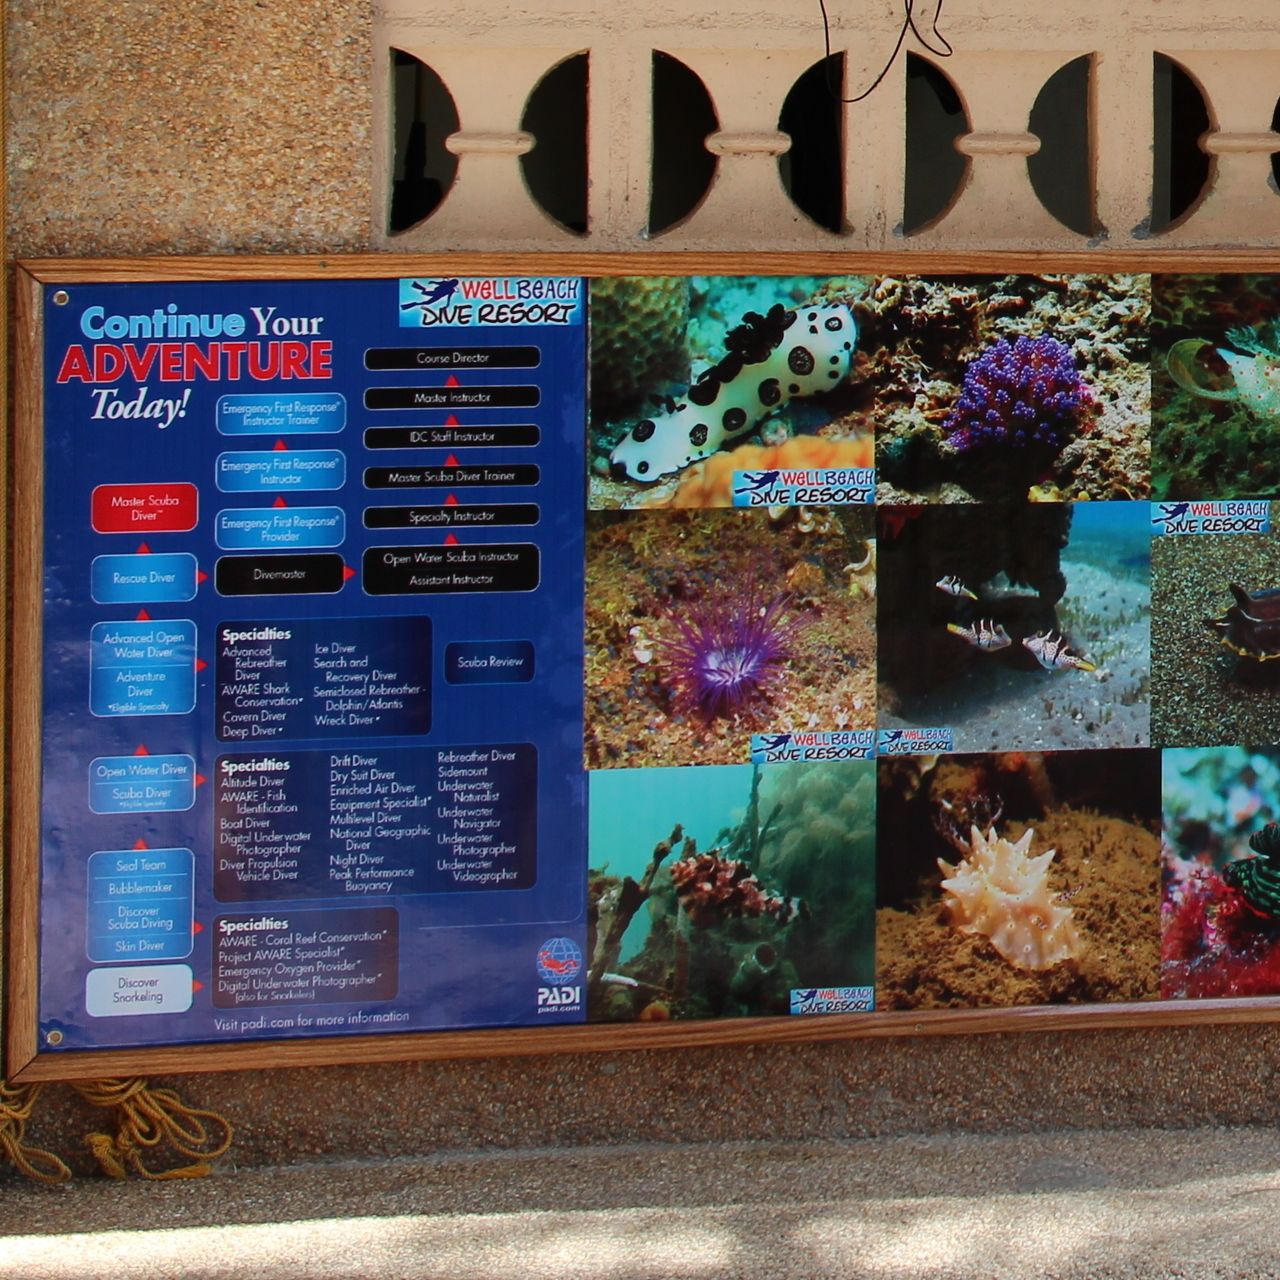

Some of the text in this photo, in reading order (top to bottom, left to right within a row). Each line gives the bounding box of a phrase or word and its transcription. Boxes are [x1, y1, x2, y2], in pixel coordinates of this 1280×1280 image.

[421, 303, 576, 325] DIVE RESORT
[80, 303, 324, 339] Continue Your
[56, 340, 333, 383] ADVENTURE
[417, 352, 489, 364] Course Director
[414, 392, 491, 403] Master Instructor
[91, 386, 191, 429] Today!
[223, 402, 272, 417] Emergency
[275, 402, 293, 413] First
[243, 414, 319, 426] Instructor Trainer
[410, 431, 495, 442] IDC Staff Instructor
[222, 459, 271, 474] Emergency
[274, 459, 292, 470] First
[261, 474, 301, 484] Instructor
[388, 470, 515, 483] Master Scuba Diver Trainer
[112, 495, 179, 507] Master Scuba
[751, 487, 871, 505] DIVE RESORT
[409, 510, 495, 524] Specialty Instructor
[222, 517, 271, 532] Emergency
[274, 516, 292, 527] First
[1166, 518, 1265, 533] DIVE RESORT
[261, 531, 300, 542] Provider
[383, 551, 519, 566] Open Water Scuba Instructor
[113, 572, 175, 584] Rescue Diver
[254, 569, 305, 580] Divemaster
[409, 574, 494, 585] Assistant Instructor
[103, 633, 185, 646] Advanced Open
[222, 627, 291, 645] Specialties
[114, 646, 173, 659] Water Diver
[222, 646, 272, 657] Advanced
[315, 643, 356, 654] Ice Diver
[235, 658, 287, 668] Rebreather
[314, 657, 368, 668] Search and
[457, 655, 524, 668] Scuba Review
[116, 671, 166, 682] Adventure
[235, 671, 261, 681] Diver
[326, 670, 397, 683] Recovery Diver
[128, 686, 153, 697] Diver
[223, 711, 286, 722] Cavern Diver
[888, 741, 950, 751] DIVE RESORT
[438, 750, 516, 763] Rebreather Diver
[767, 747, 870, 761] DIVE RESORT
[221, 759, 290, 775] Specialties
[330, 755, 378, 767] Drift Diver
[97, 763, 187, 779] Open Water Diver
[330, 769, 396, 783] Dry Suit Diver
[112, 787, 171, 799] Scuba Diver
[220, 818, 270, 829] Boat Diver
[116, 859, 166, 871] Seal Team
[330, 854, 384, 868] Night Diver
[109, 882, 172, 894] Bubblemaker
[118, 906, 159, 917] Discover
[108, 917, 173, 930] Scuba Diving
[219, 918, 289, 935] Specialties
[116, 939, 165, 951] Skin Diver
[118, 977, 159, 988] Discover
[113, 991, 163, 1005] Snorkeling
[537, 987, 581, 1005] PADI
[538, 1005, 581, 1014] padi.com
[827, 1000, 871, 1011] RESORT
[214, 1011, 409, 1033] Visit padi.com for more information
